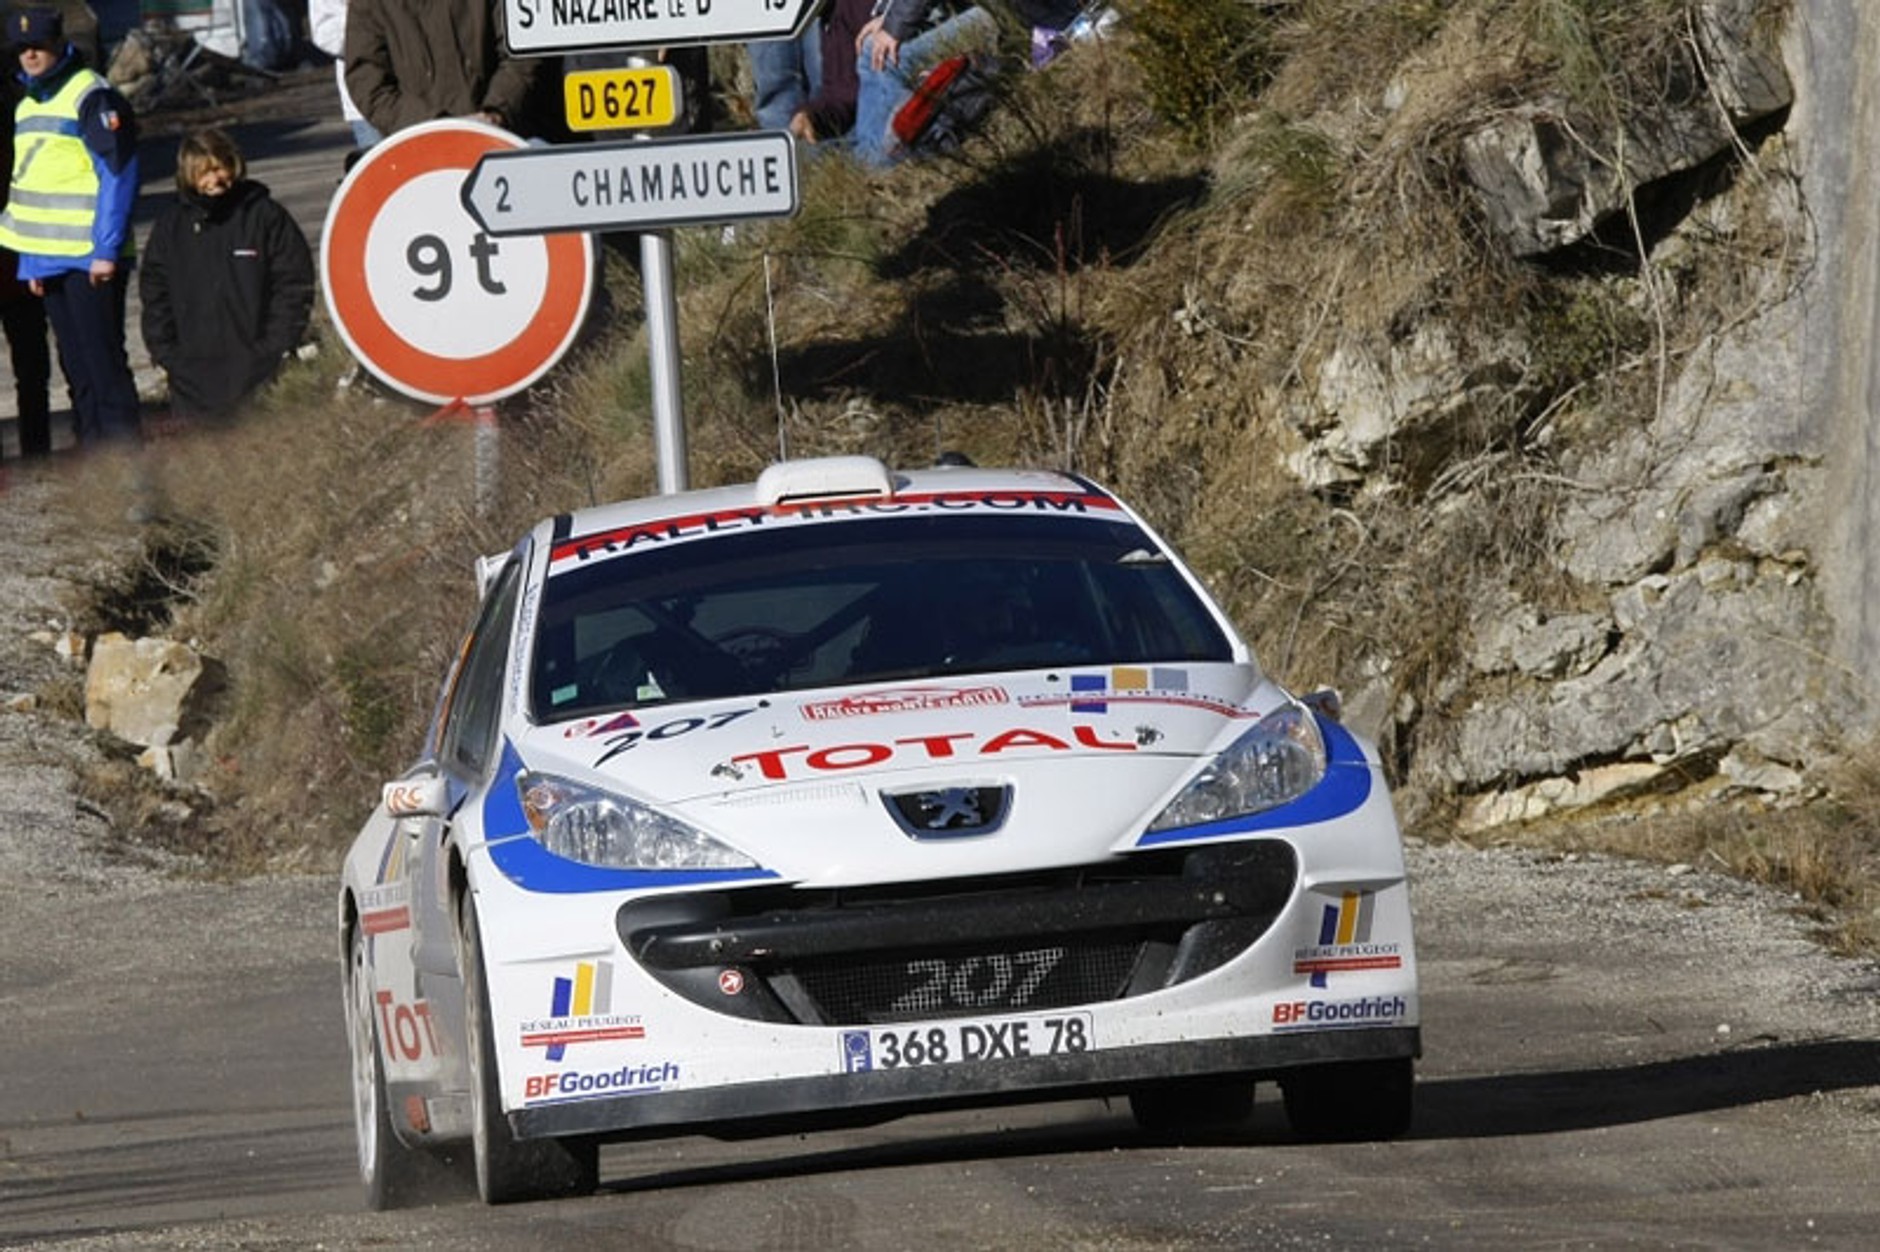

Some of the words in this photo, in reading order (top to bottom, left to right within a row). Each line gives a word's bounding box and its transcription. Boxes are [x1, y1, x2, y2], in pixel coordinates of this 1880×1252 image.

[552, 0, 659, 26] NAZAIRE
[580, 84, 595, 119] D
[603, 79, 656, 118] 627
[494, 176, 512, 213] 2
[572, 156, 781, 207] CHAMAUCHE
[406, 233, 452, 302] 9
[469, 232, 507, 295] t
[593, 708, 758, 769] 207
[731, 726, 1138, 779] TOTAL
[892, 948, 1064, 1013] 207
[1272, 996, 1406, 1024] BFGoodrich
[879, 1028, 949, 1068] 368
[959, 1022, 1031, 1062] DXE
[1044, 1017, 1087, 1055] 78
[525, 1062, 680, 1098] BFGoodrich
